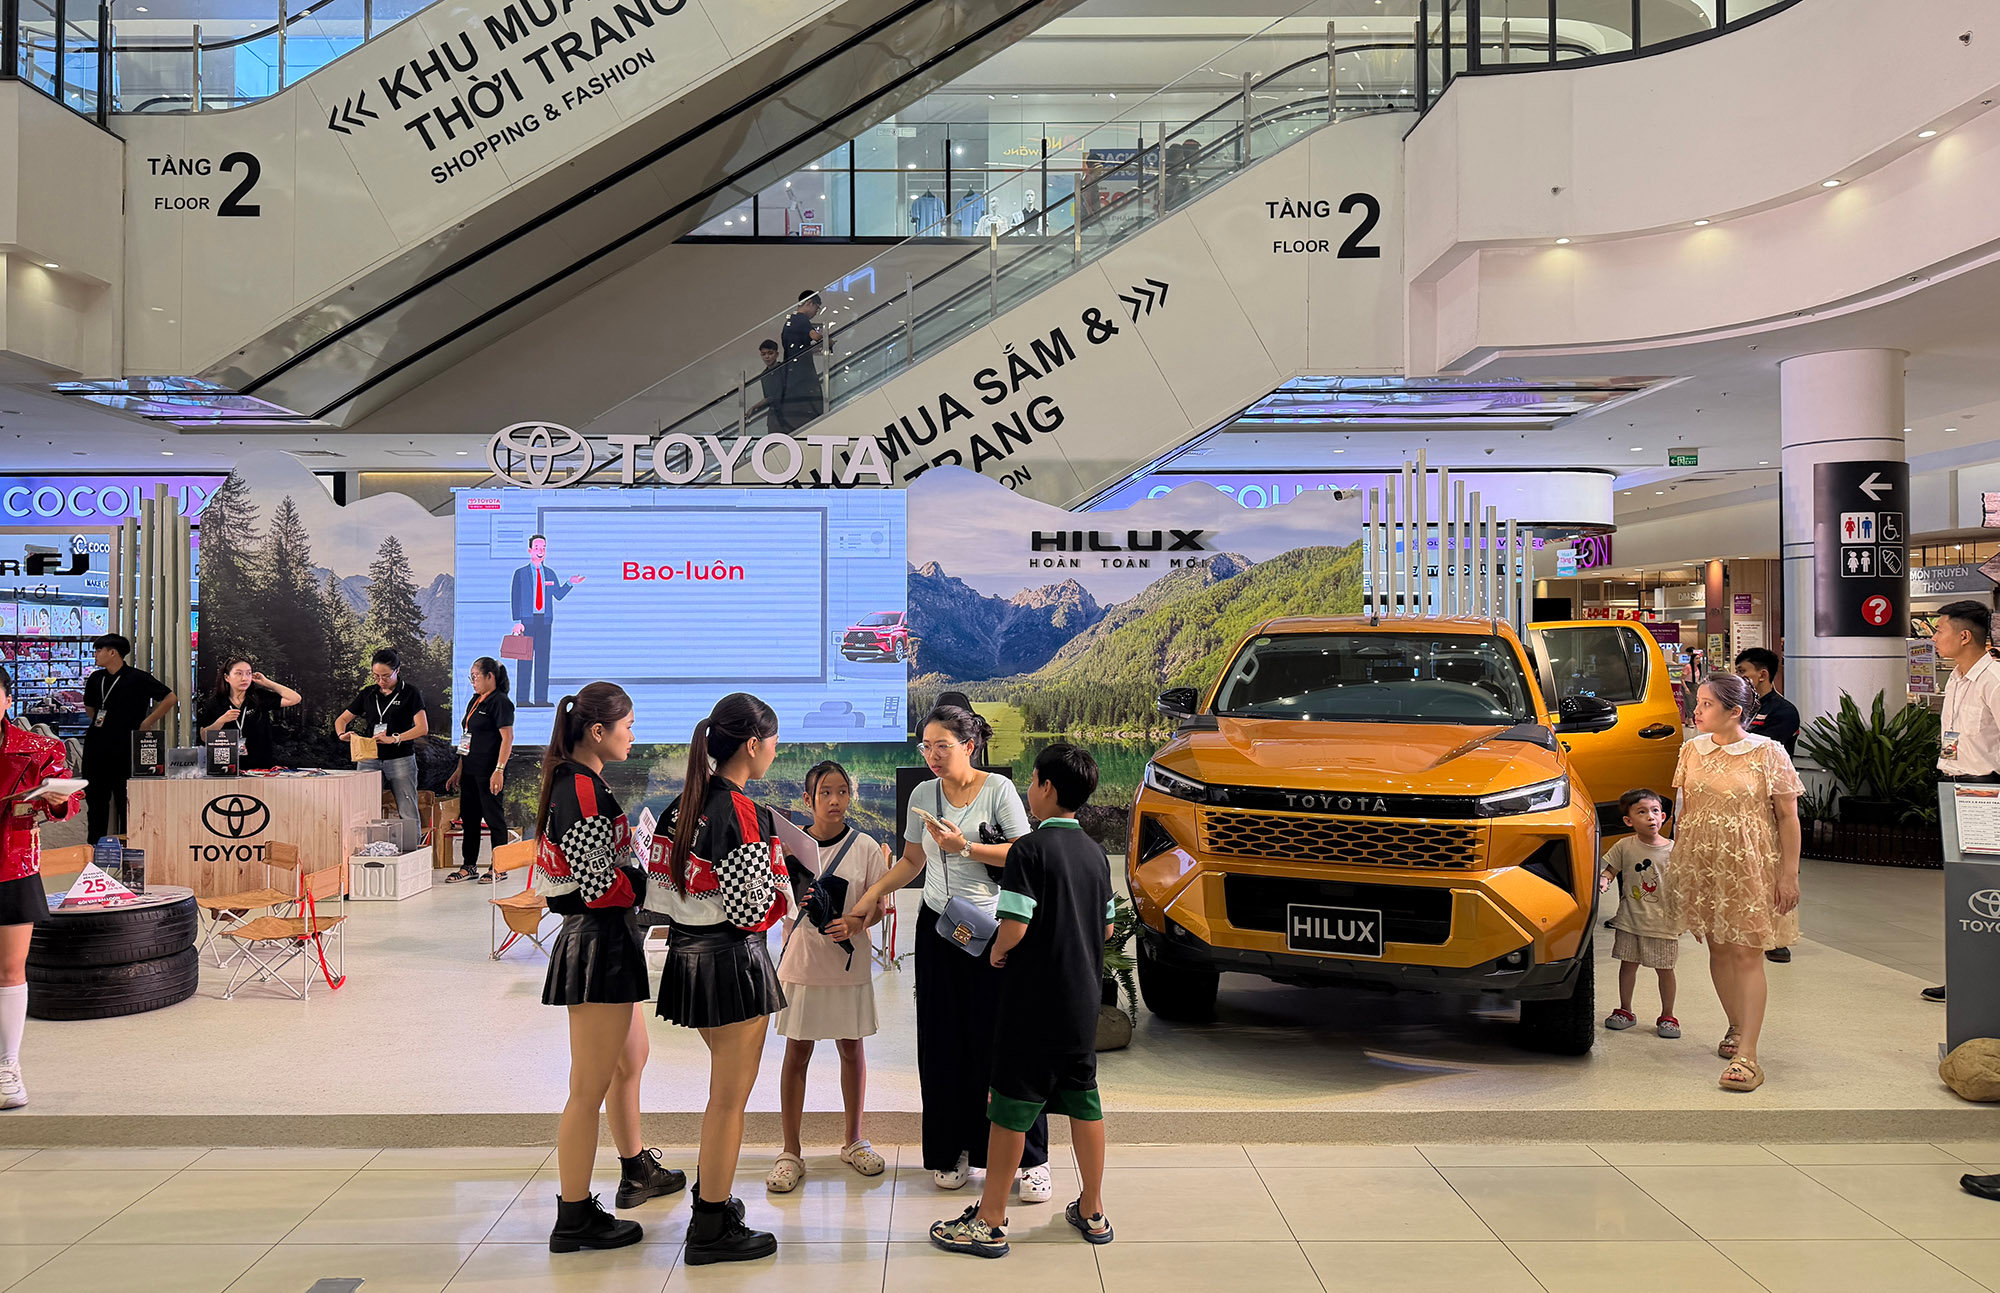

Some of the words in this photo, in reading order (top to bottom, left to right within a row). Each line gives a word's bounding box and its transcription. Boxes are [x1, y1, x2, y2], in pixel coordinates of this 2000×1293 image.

[378, 31, 479, 111] KHU
[404, 68, 524, 151] THỜI
[430, 114, 540, 184] SHOPPING
[543, 103, 561, 121] &
[562, 47, 656, 110] FASHION
[147, 154, 211, 175] TẦNG
[217, 152, 261, 216] 2
[154, 198, 210, 209] FLOOR
[1265, 197, 1330, 218] TẦNG
[1337, 193, 1380, 258] 2
[1273, 240, 1329, 253] FLOOR
[973, 327, 1076, 405] SẮM
[1082, 307, 1119, 344] &
[608, 433, 893, 485] TOYOTA
[1031, 529, 1205, 551] HILUX
[27, 553, 89, 576] FJ
[623, 560, 745, 581] Bao-luôn
[1029, 555, 1079, 568] HOÀN
[1101, 556, 1148, 568] TOÀN
[1170, 556, 1206, 568] MỚI
[1910, 568, 1930, 580] MÓN
[14, 584, 59, 599] MỚI
[1285, 794, 1387, 812] TOYOTA
[189, 844, 265, 862] TOYOT
[591, 857, 607, 871] 48
[82, 878, 115, 894] 25%
[750, 889, 764, 902] 48
[1294, 916, 1375, 943] HILUX
